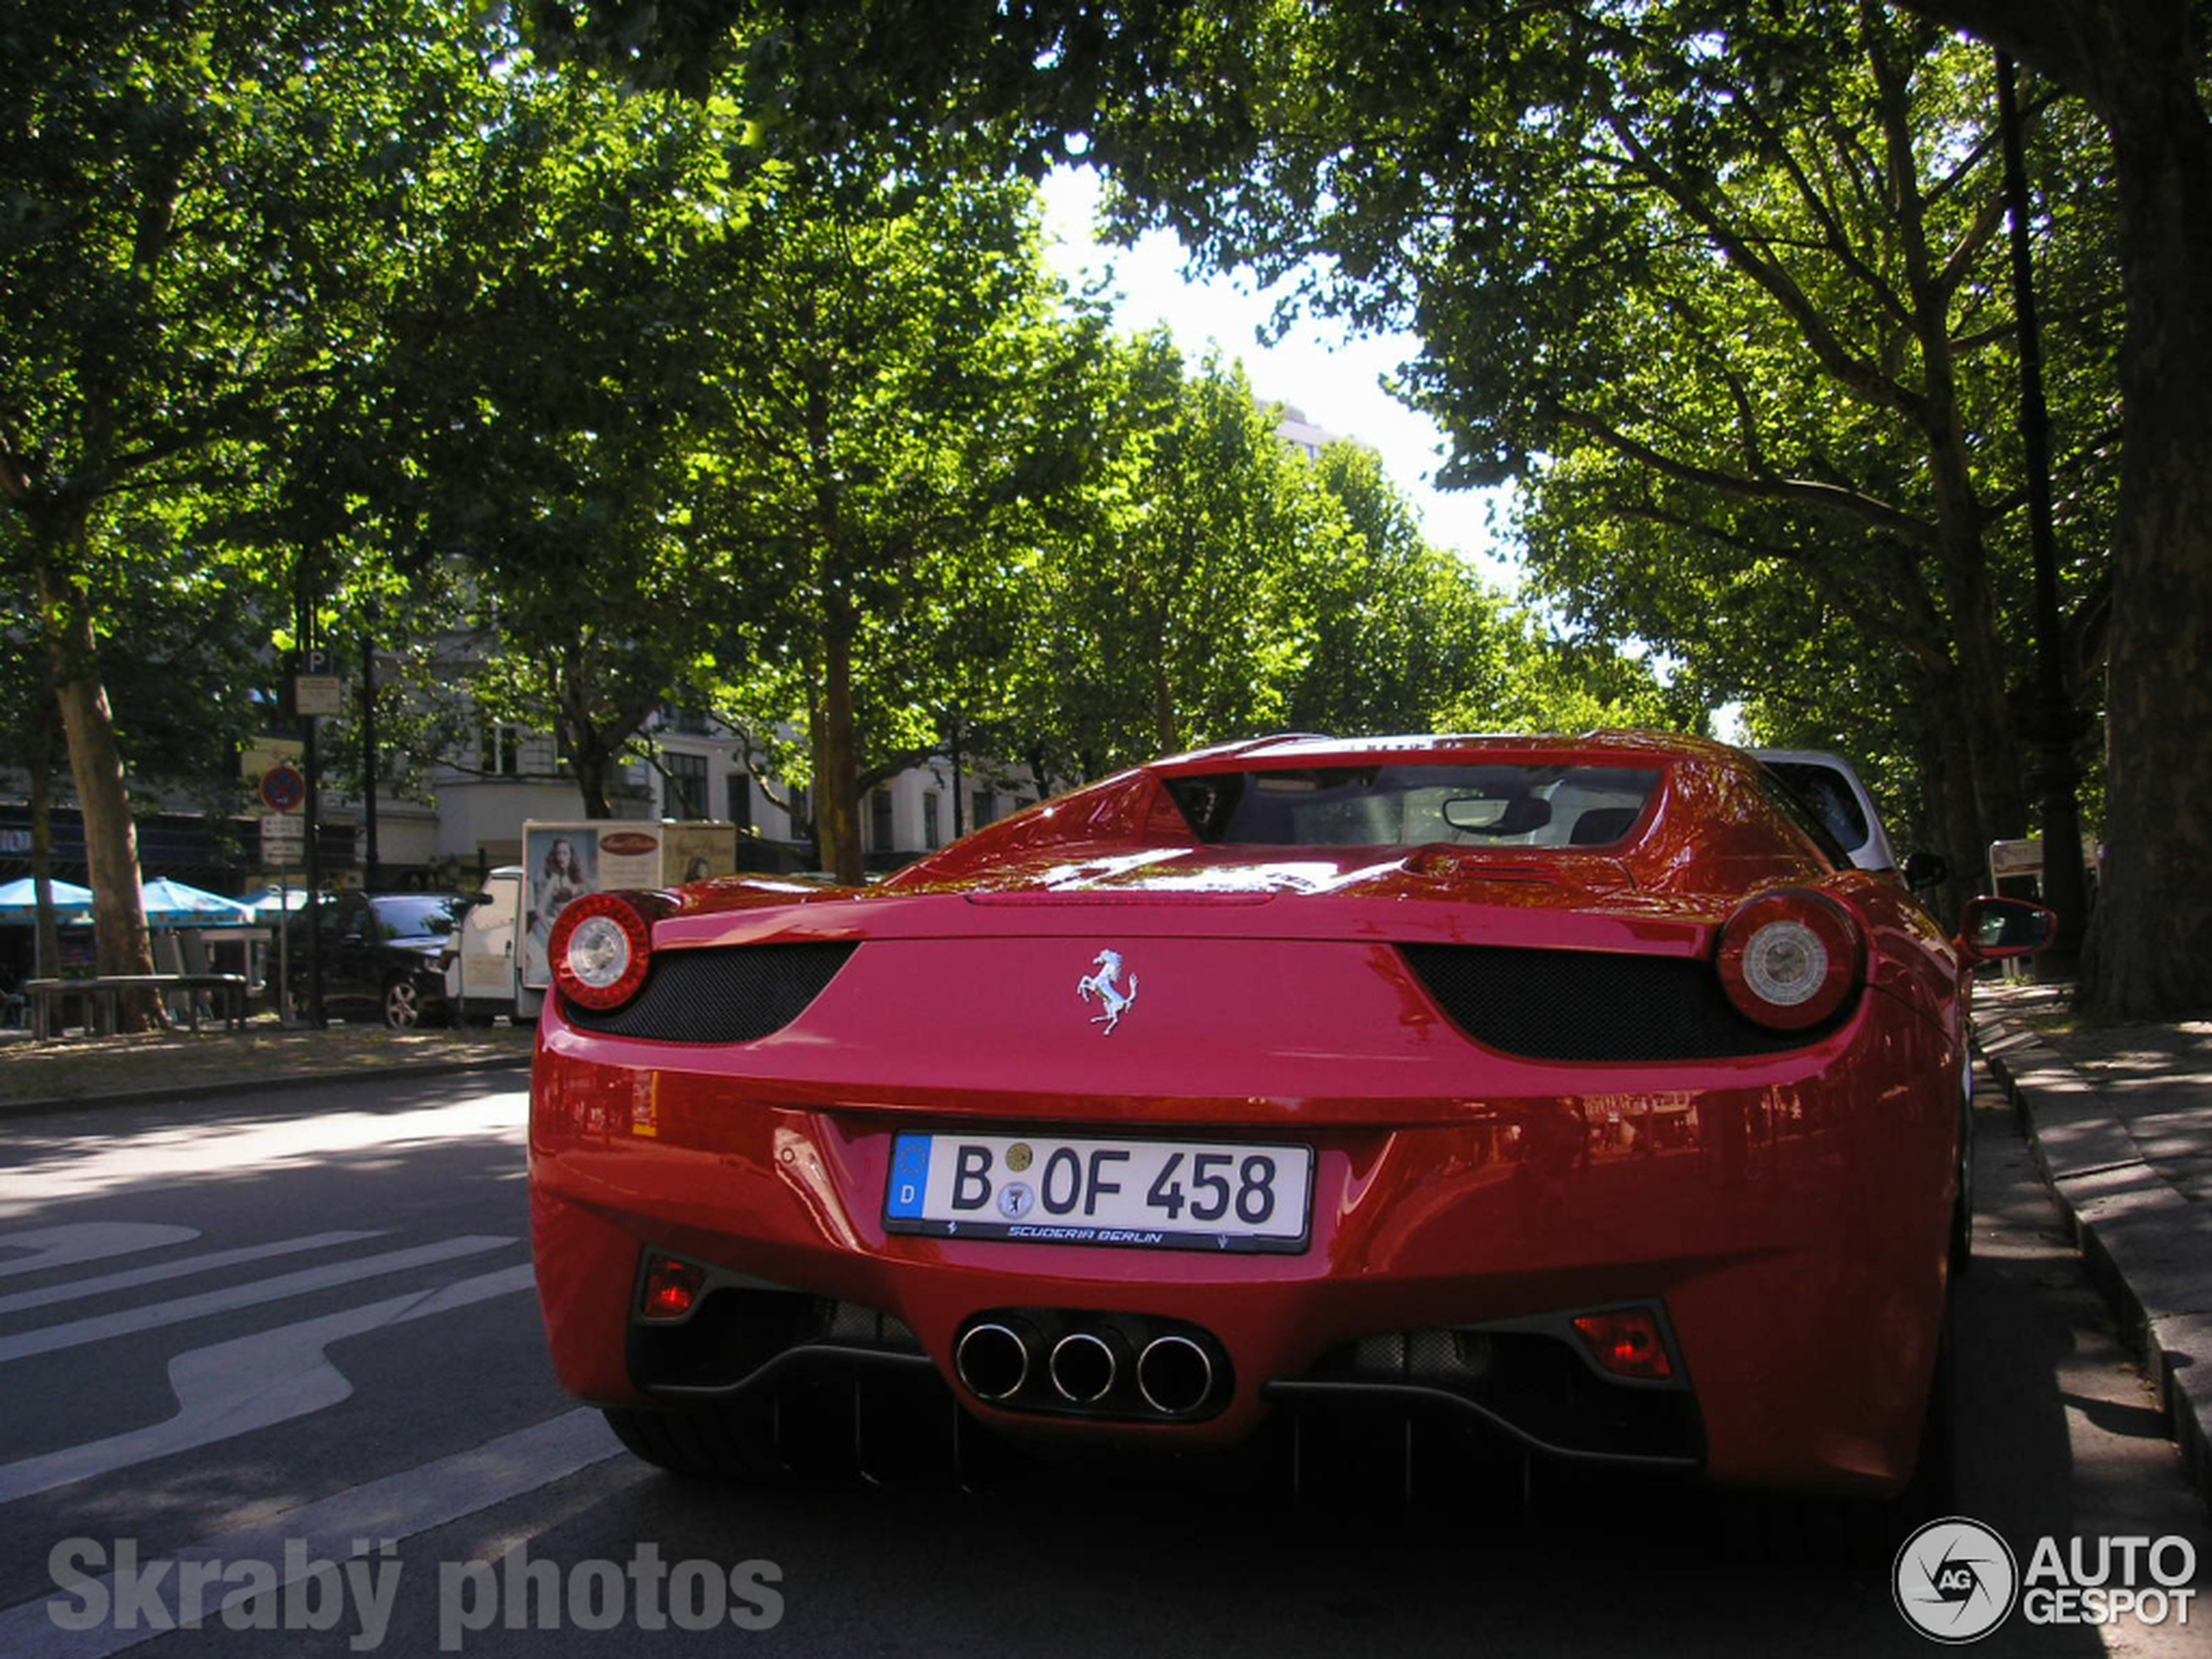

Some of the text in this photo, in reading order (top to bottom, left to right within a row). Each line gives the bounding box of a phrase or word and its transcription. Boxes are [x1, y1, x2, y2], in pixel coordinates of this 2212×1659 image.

[310, 652, 326, 672] P
[900, 1184, 915, 1204] D
[952, 1145, 1277, 1224] B OF 458
[1008, 1226, 1163, 1244] SCUDERIA BERLIN
